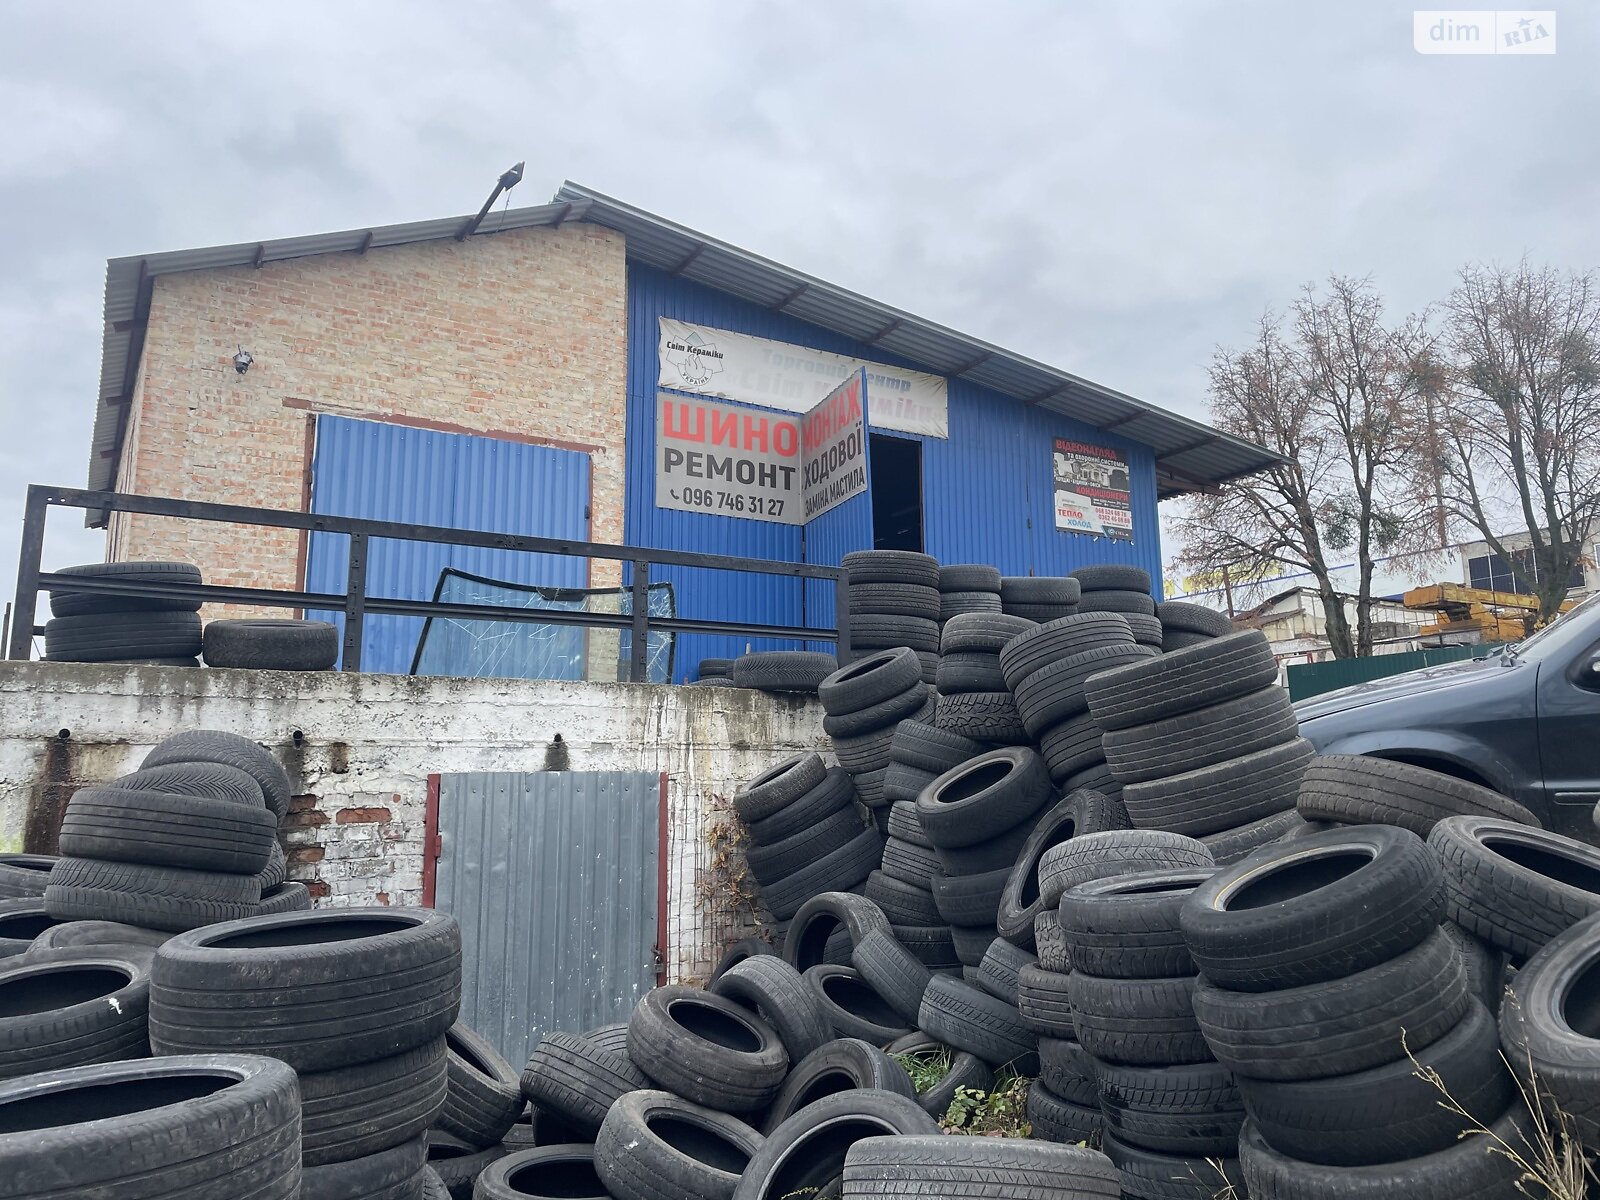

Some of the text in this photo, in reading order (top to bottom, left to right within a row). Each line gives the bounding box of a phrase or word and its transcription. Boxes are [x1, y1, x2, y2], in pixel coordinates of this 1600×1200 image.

[666, 341, 724, 360] Світ Кераміки
[762, 348, 912, 393] Торговий ентр
[682, 372, 709, 385] УКРАЇНА
[663, 401, 798, 457] ШИНО
[803, 379, 861, 456] МОНТАЖ
[664, 447, 796, 491] РЕМОНТ
[804, 421, 862, 490] ХОДОВОЇ
[683, 487, 784, 516] 096 746 31 27
[805, 466, 865, 517] ЗАМІНА МАСТИЛА
[1058, 509, 1083, 519] ТЕПЛО
[1067, 519, 1092, 529] ХОЛОД
